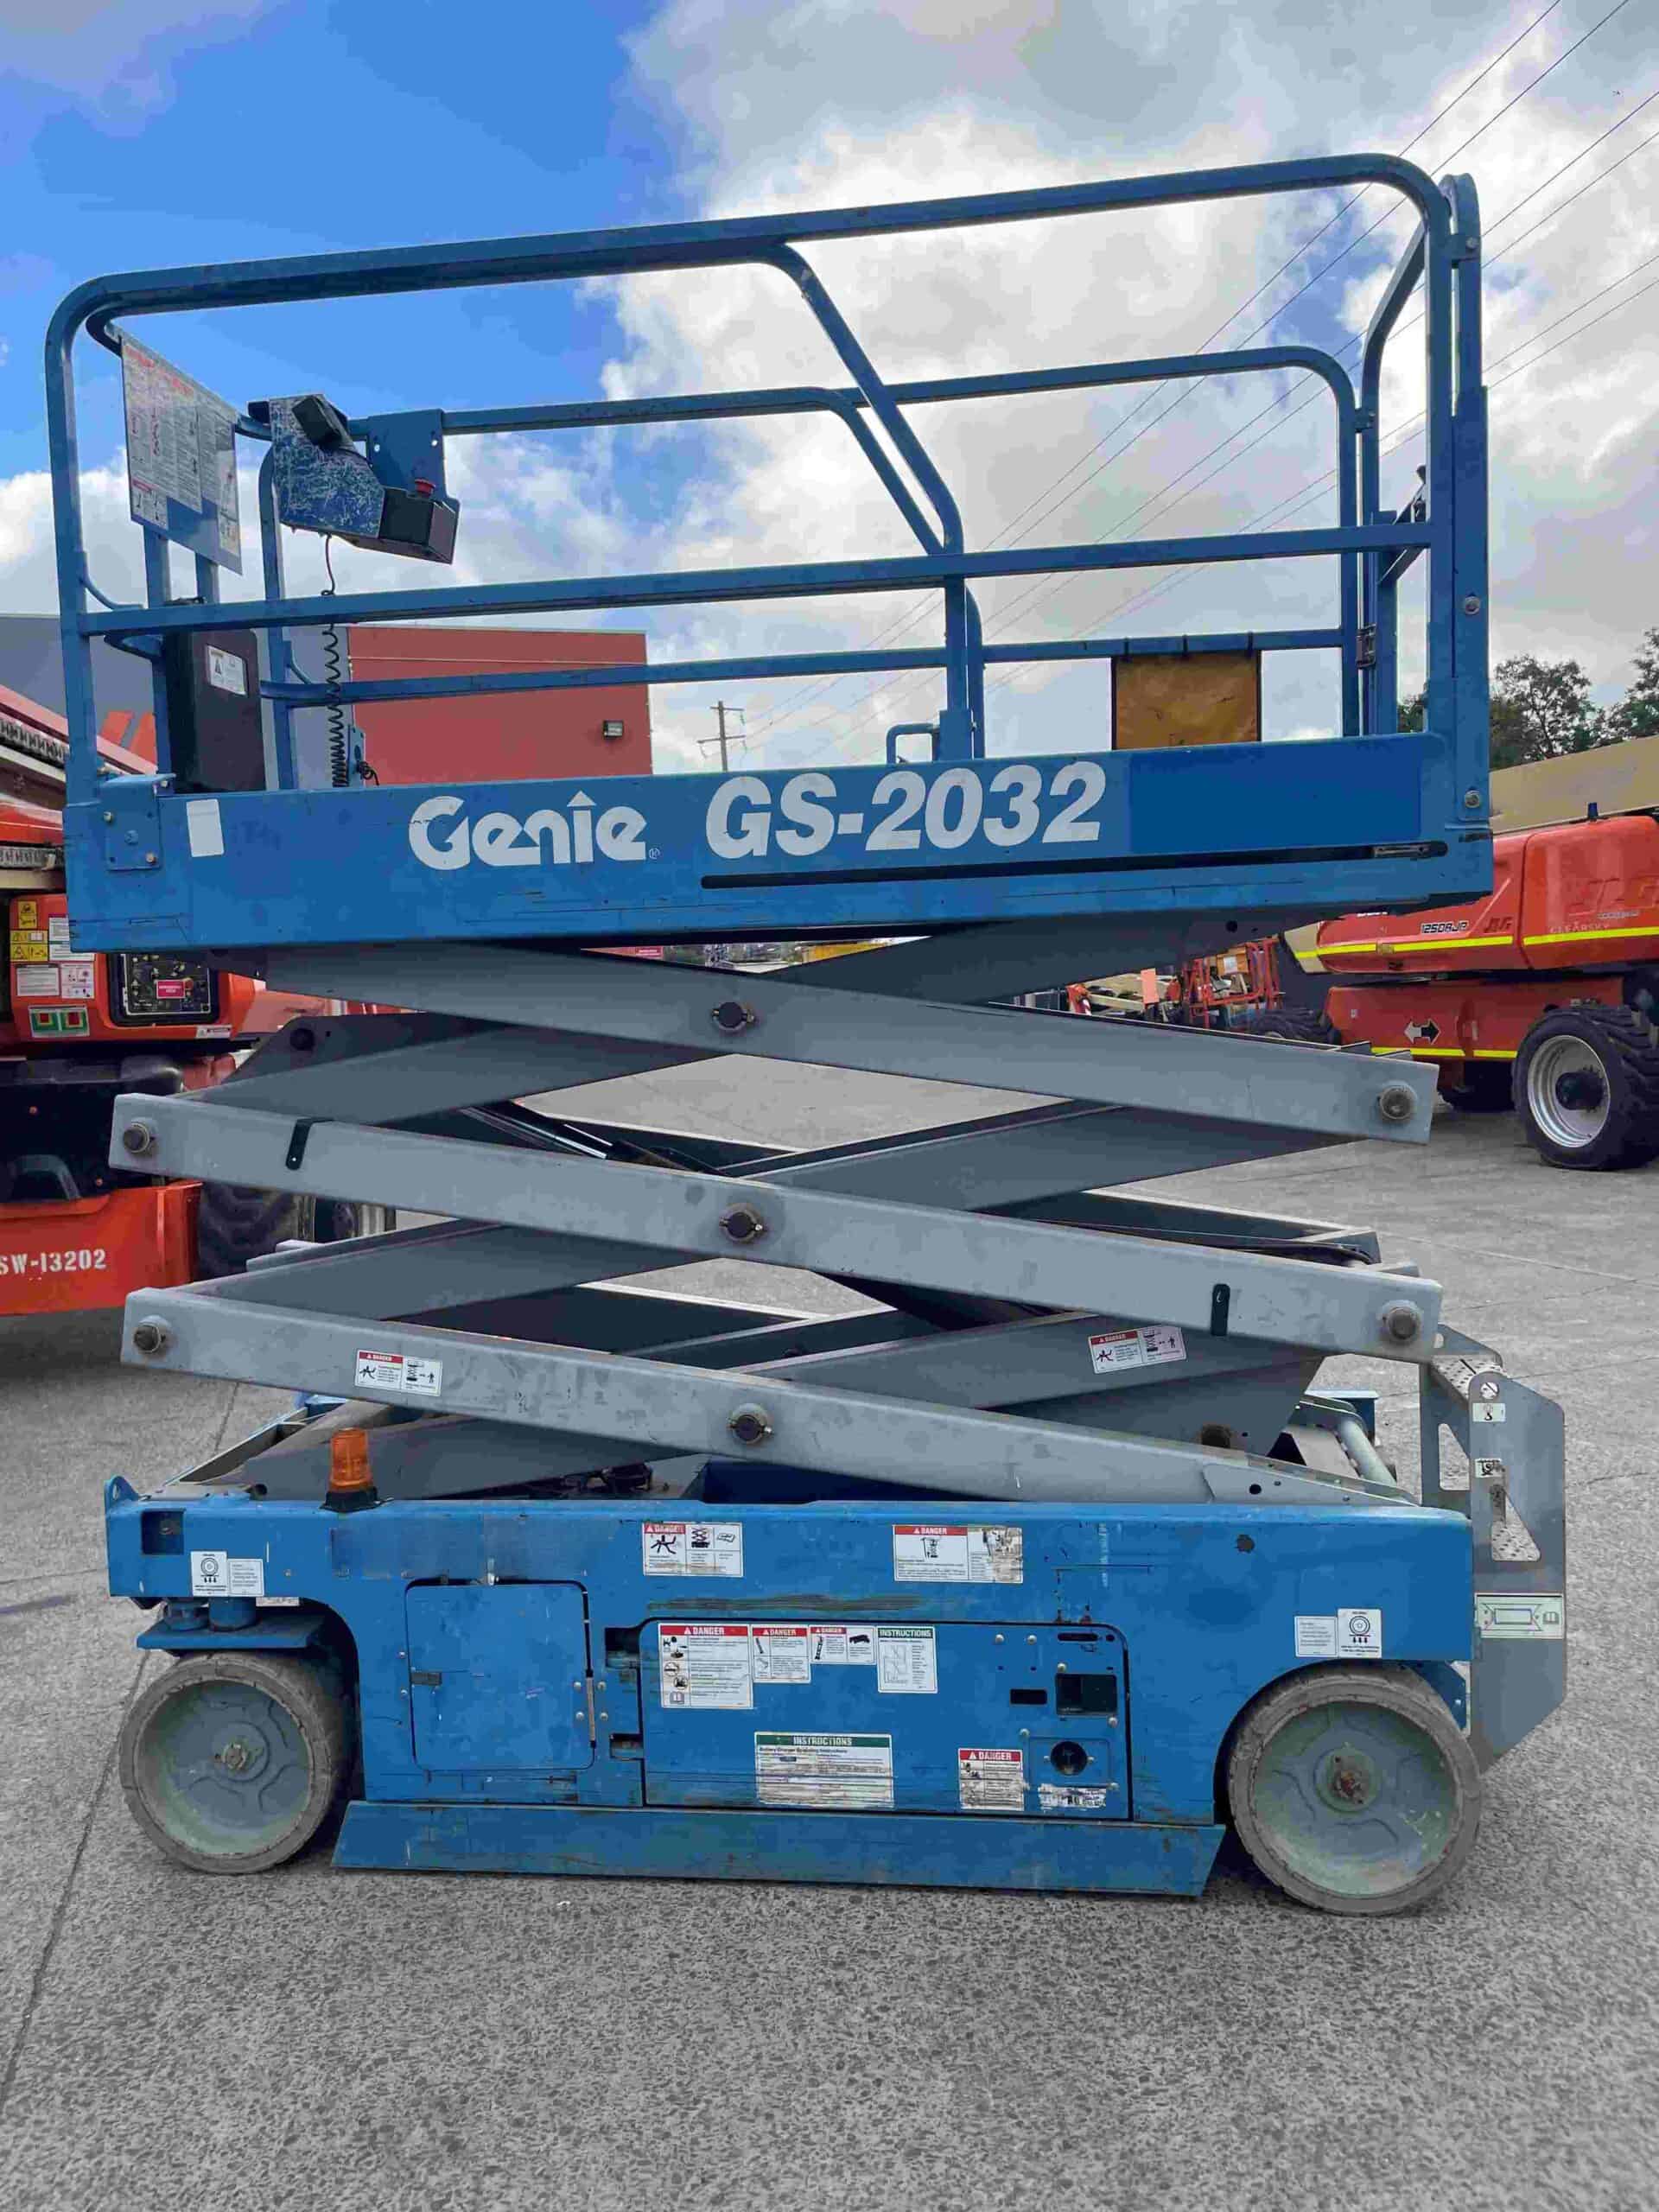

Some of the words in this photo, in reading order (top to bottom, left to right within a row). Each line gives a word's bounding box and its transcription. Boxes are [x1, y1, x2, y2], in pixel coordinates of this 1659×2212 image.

[705, 760, 1107, 860] GS-2032
[408, 790, 648, 871] Genie
[0, 1249, 107, 1275] SW-13202
[920, 1527, 948, 1535] DANGER
[692, 1626, 726, 1636] DANGER
[879, 1629, 932, 1638] INSTRUCTIONS
[793, 1737, 853, 1746] INSTRUCTIONS
[978, 1751, 1012, 1761] DANGER
